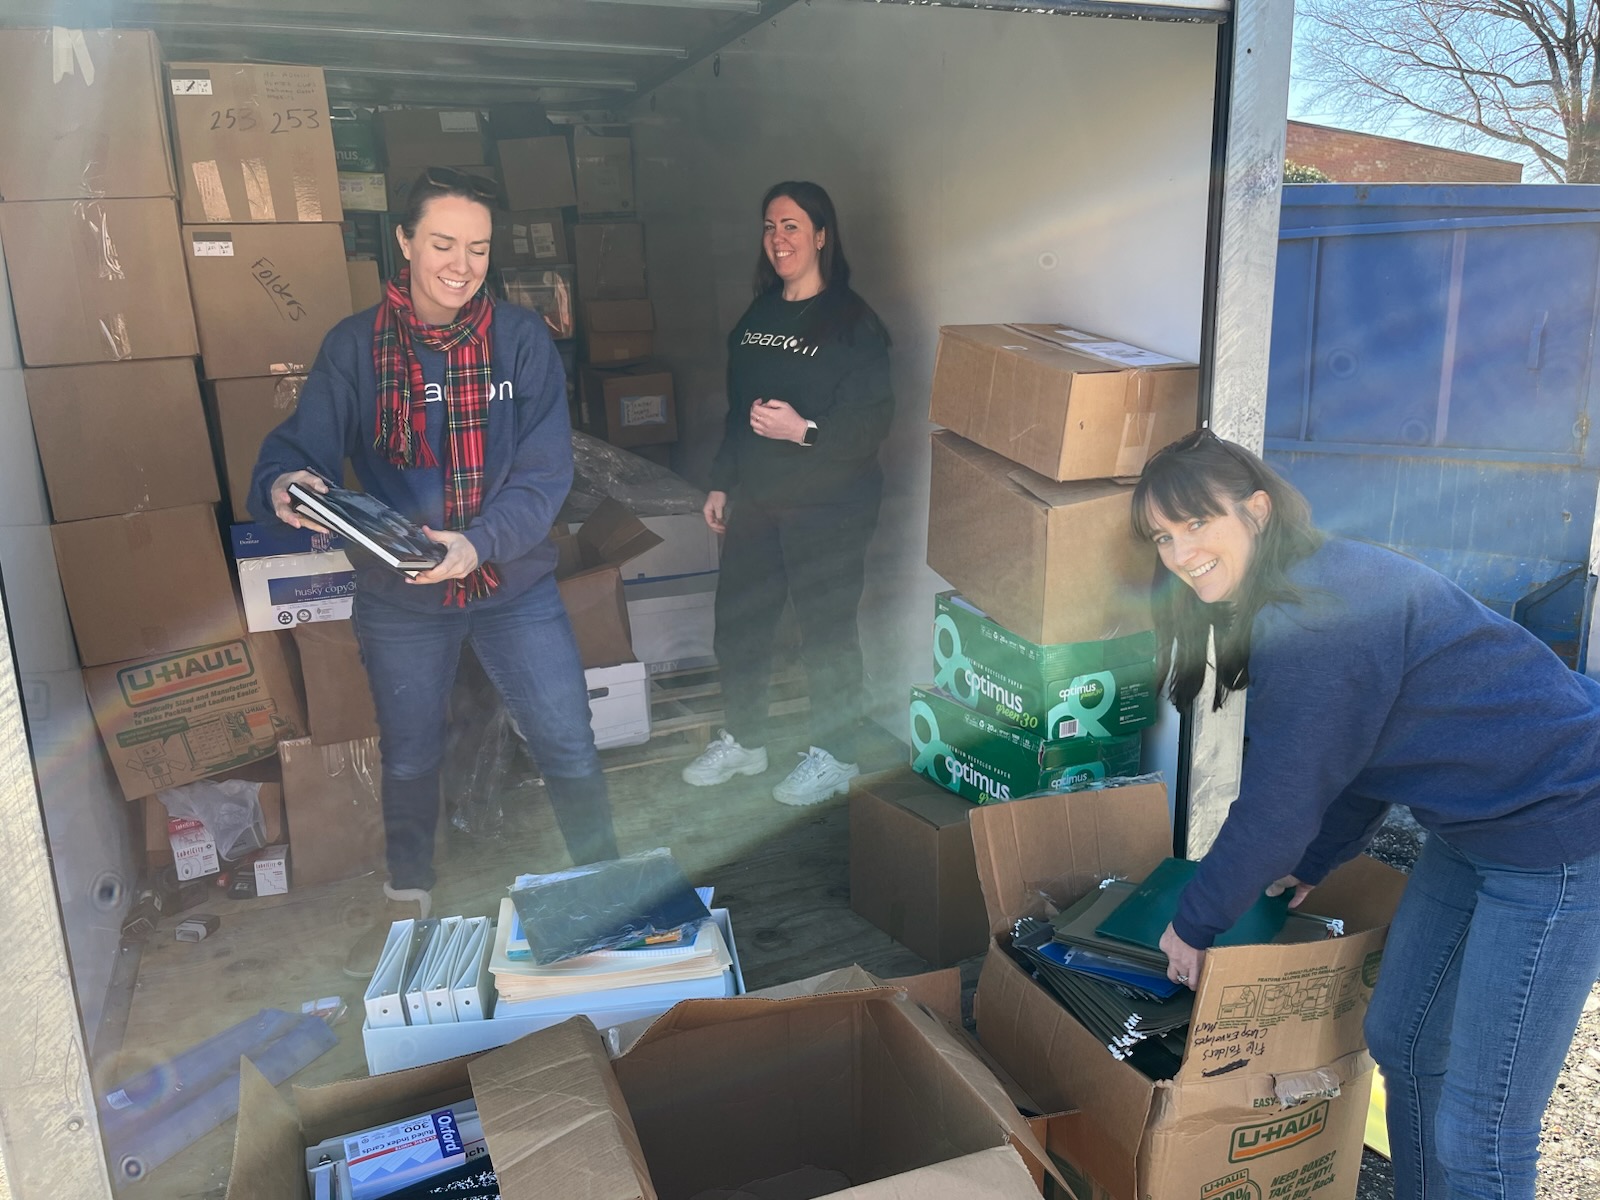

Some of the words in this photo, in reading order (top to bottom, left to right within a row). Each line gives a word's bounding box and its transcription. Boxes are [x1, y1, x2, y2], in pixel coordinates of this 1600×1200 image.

[210, 107, 257, 131] 253
[270, 108, 320, 134] 253
[251, 257, 307, 321] Folders
[294, 586, 323, 597] husky
[325, 581, 357, 595] copy3
[127, 648, 243, 691] U-HAUL
[175, 697, 194, 708] Sized
[195, 692, 209, 702] and
[964, 669, 1023, 714] optimus
[1059, 683, 1097, 702] optimus
[193, 700, 207, 710] and
[945, 756, 1010, 802] optimus
[1203, 1044, 1242, 1061] Folders
[1246, 1041, 1266, 1056] File
[404, 1121, 430, 1133] 300
[411, 1128, 435, 1141] Ruled
[437, 1115, 461, 1152] Oxford
[1238, 1108, 1323, 1149] U-HAUL
[1270, 1169, 1299, 1188] NEED
[1300, 1149, 1337, 1175] BOXES?
[1204, 1172, 1246, 1193] U-HAUL
[1268, 1181, 1295, 1199] TAKE
[1295, 1163, 1334, 1188] PLENTY!
